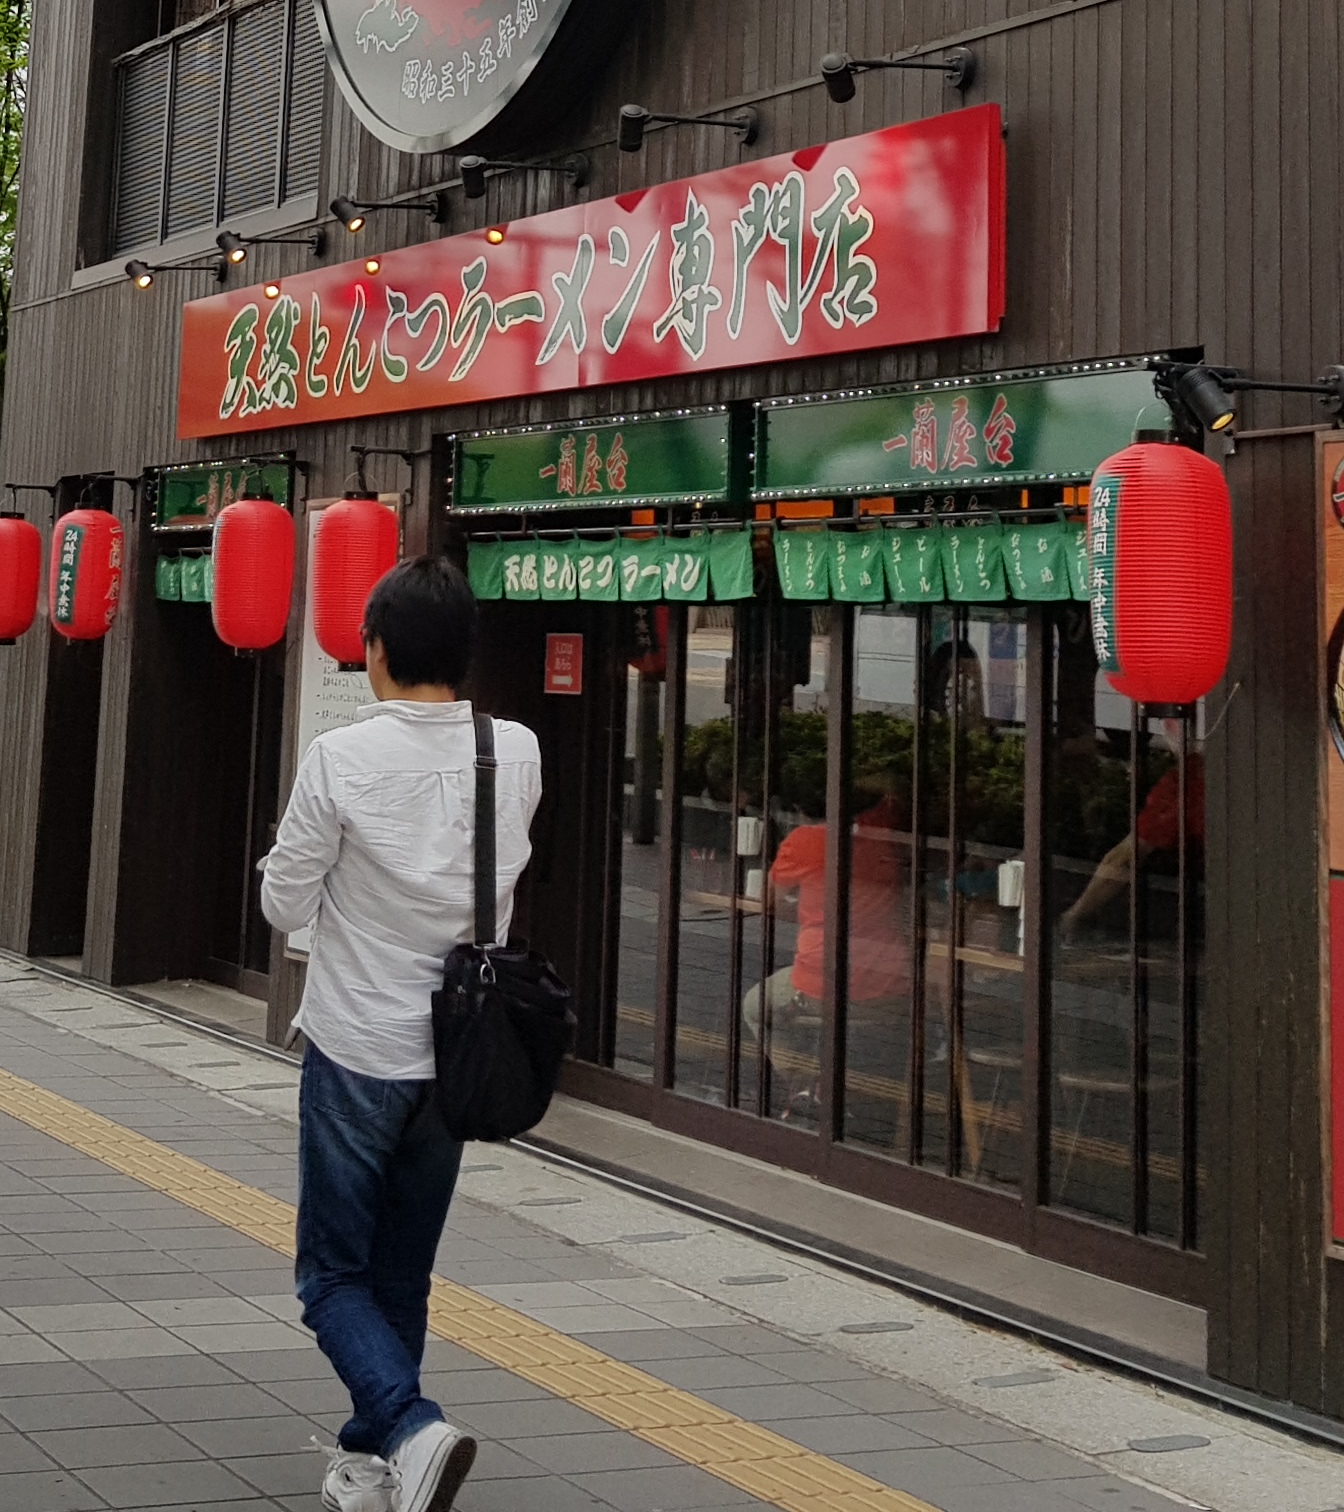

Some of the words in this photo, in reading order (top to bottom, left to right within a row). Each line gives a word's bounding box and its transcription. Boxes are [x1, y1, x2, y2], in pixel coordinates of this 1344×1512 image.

[218, 166, 881, 419] 天然とんこつラーメン専門店
[538, 432, 628, 496] 一蘭屋台
[882, 392, 1017, 475] 一蘭屋台
[504, 553, 701, 592] 天然とんこつラーメン
